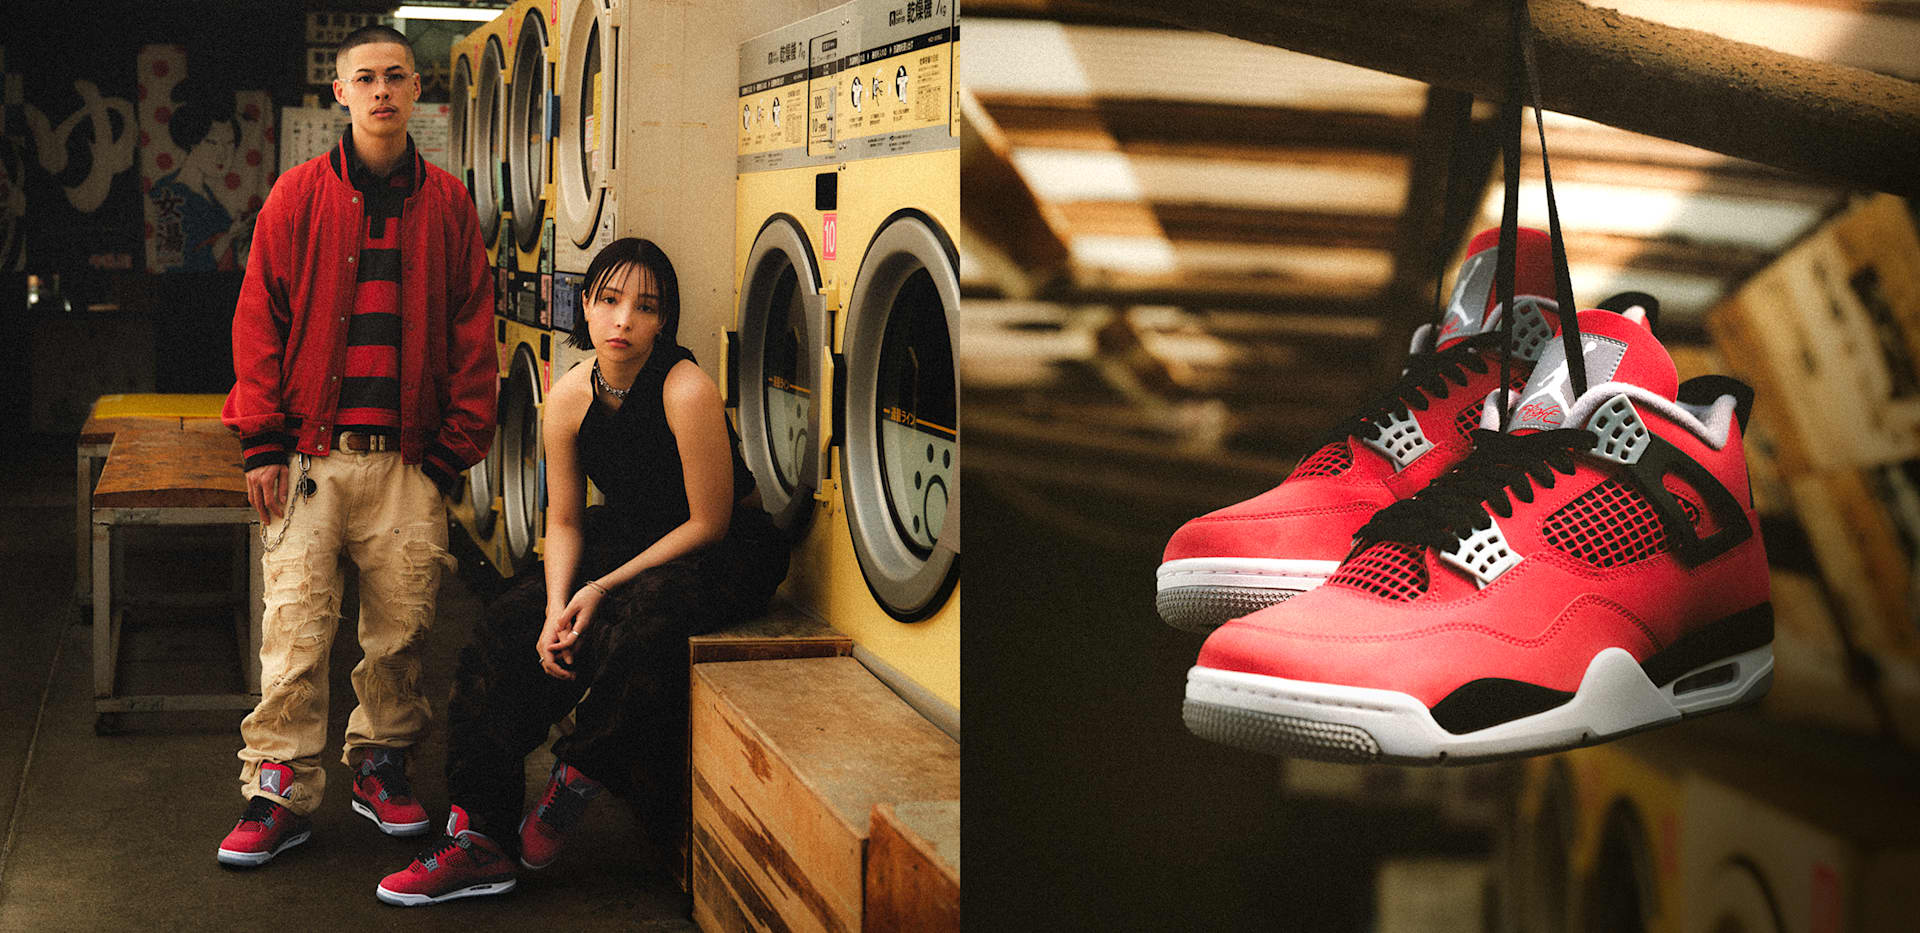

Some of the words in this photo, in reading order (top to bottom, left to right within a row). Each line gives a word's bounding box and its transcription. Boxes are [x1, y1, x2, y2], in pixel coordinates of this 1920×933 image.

[24, 79, 136, 213] ゆ
[152, 187, 184, 254] 女湯
[824, 219, 835, 253] 10
